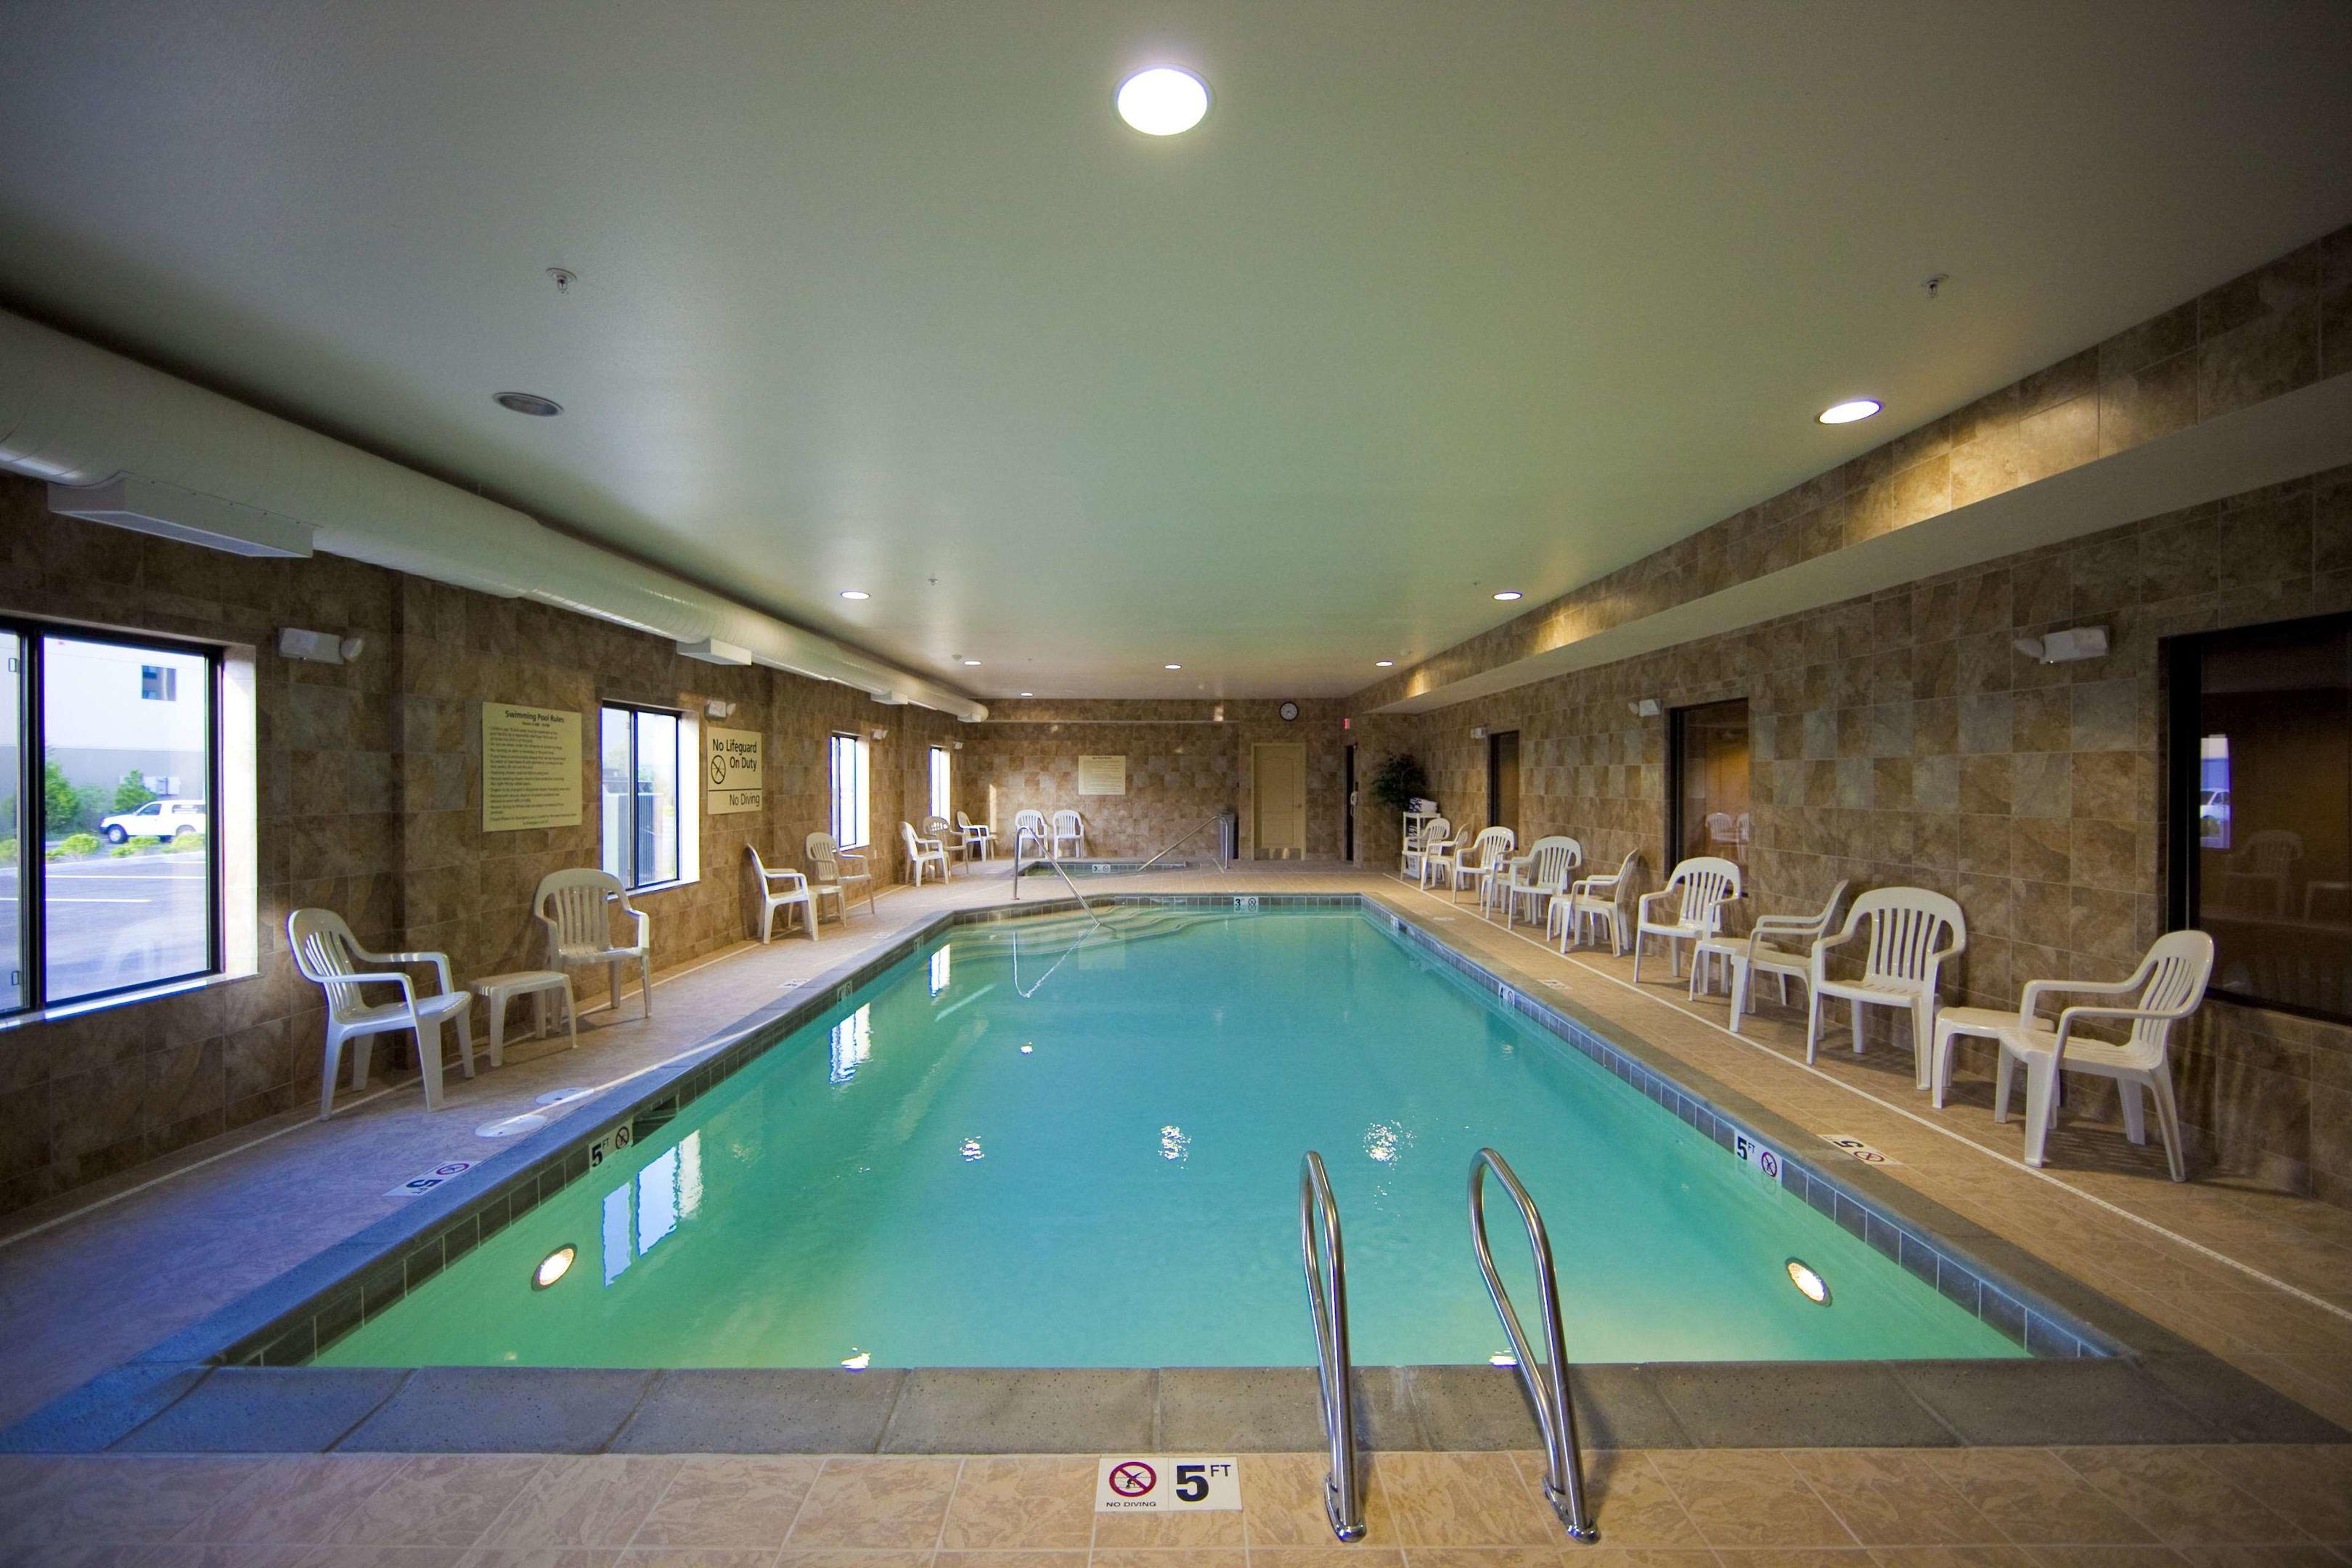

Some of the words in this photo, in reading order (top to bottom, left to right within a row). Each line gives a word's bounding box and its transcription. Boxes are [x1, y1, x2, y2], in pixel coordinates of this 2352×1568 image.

[505, 710, 536, 722] Swimming
[550, 714, 564, 723] Rules
[713, 739, 724, 751] No
[726, 739, 757, 755] Lifeguard
[730, 756, 740, 768] On
[741, 757, 757, 772] Duty
[730, 794, 739, 806] No
[740, 793, 760, 807] Diving
[592, 1143, 603, 1167] 5
[603, 1138, 610, 1149] FT
[1737, 1136, 1747, 1160] 5
[407, 1179, 444, 1188] 5
[1176, 1465, 1209, 1502] 5
[1210, 1464, 1231, 1477] FT
